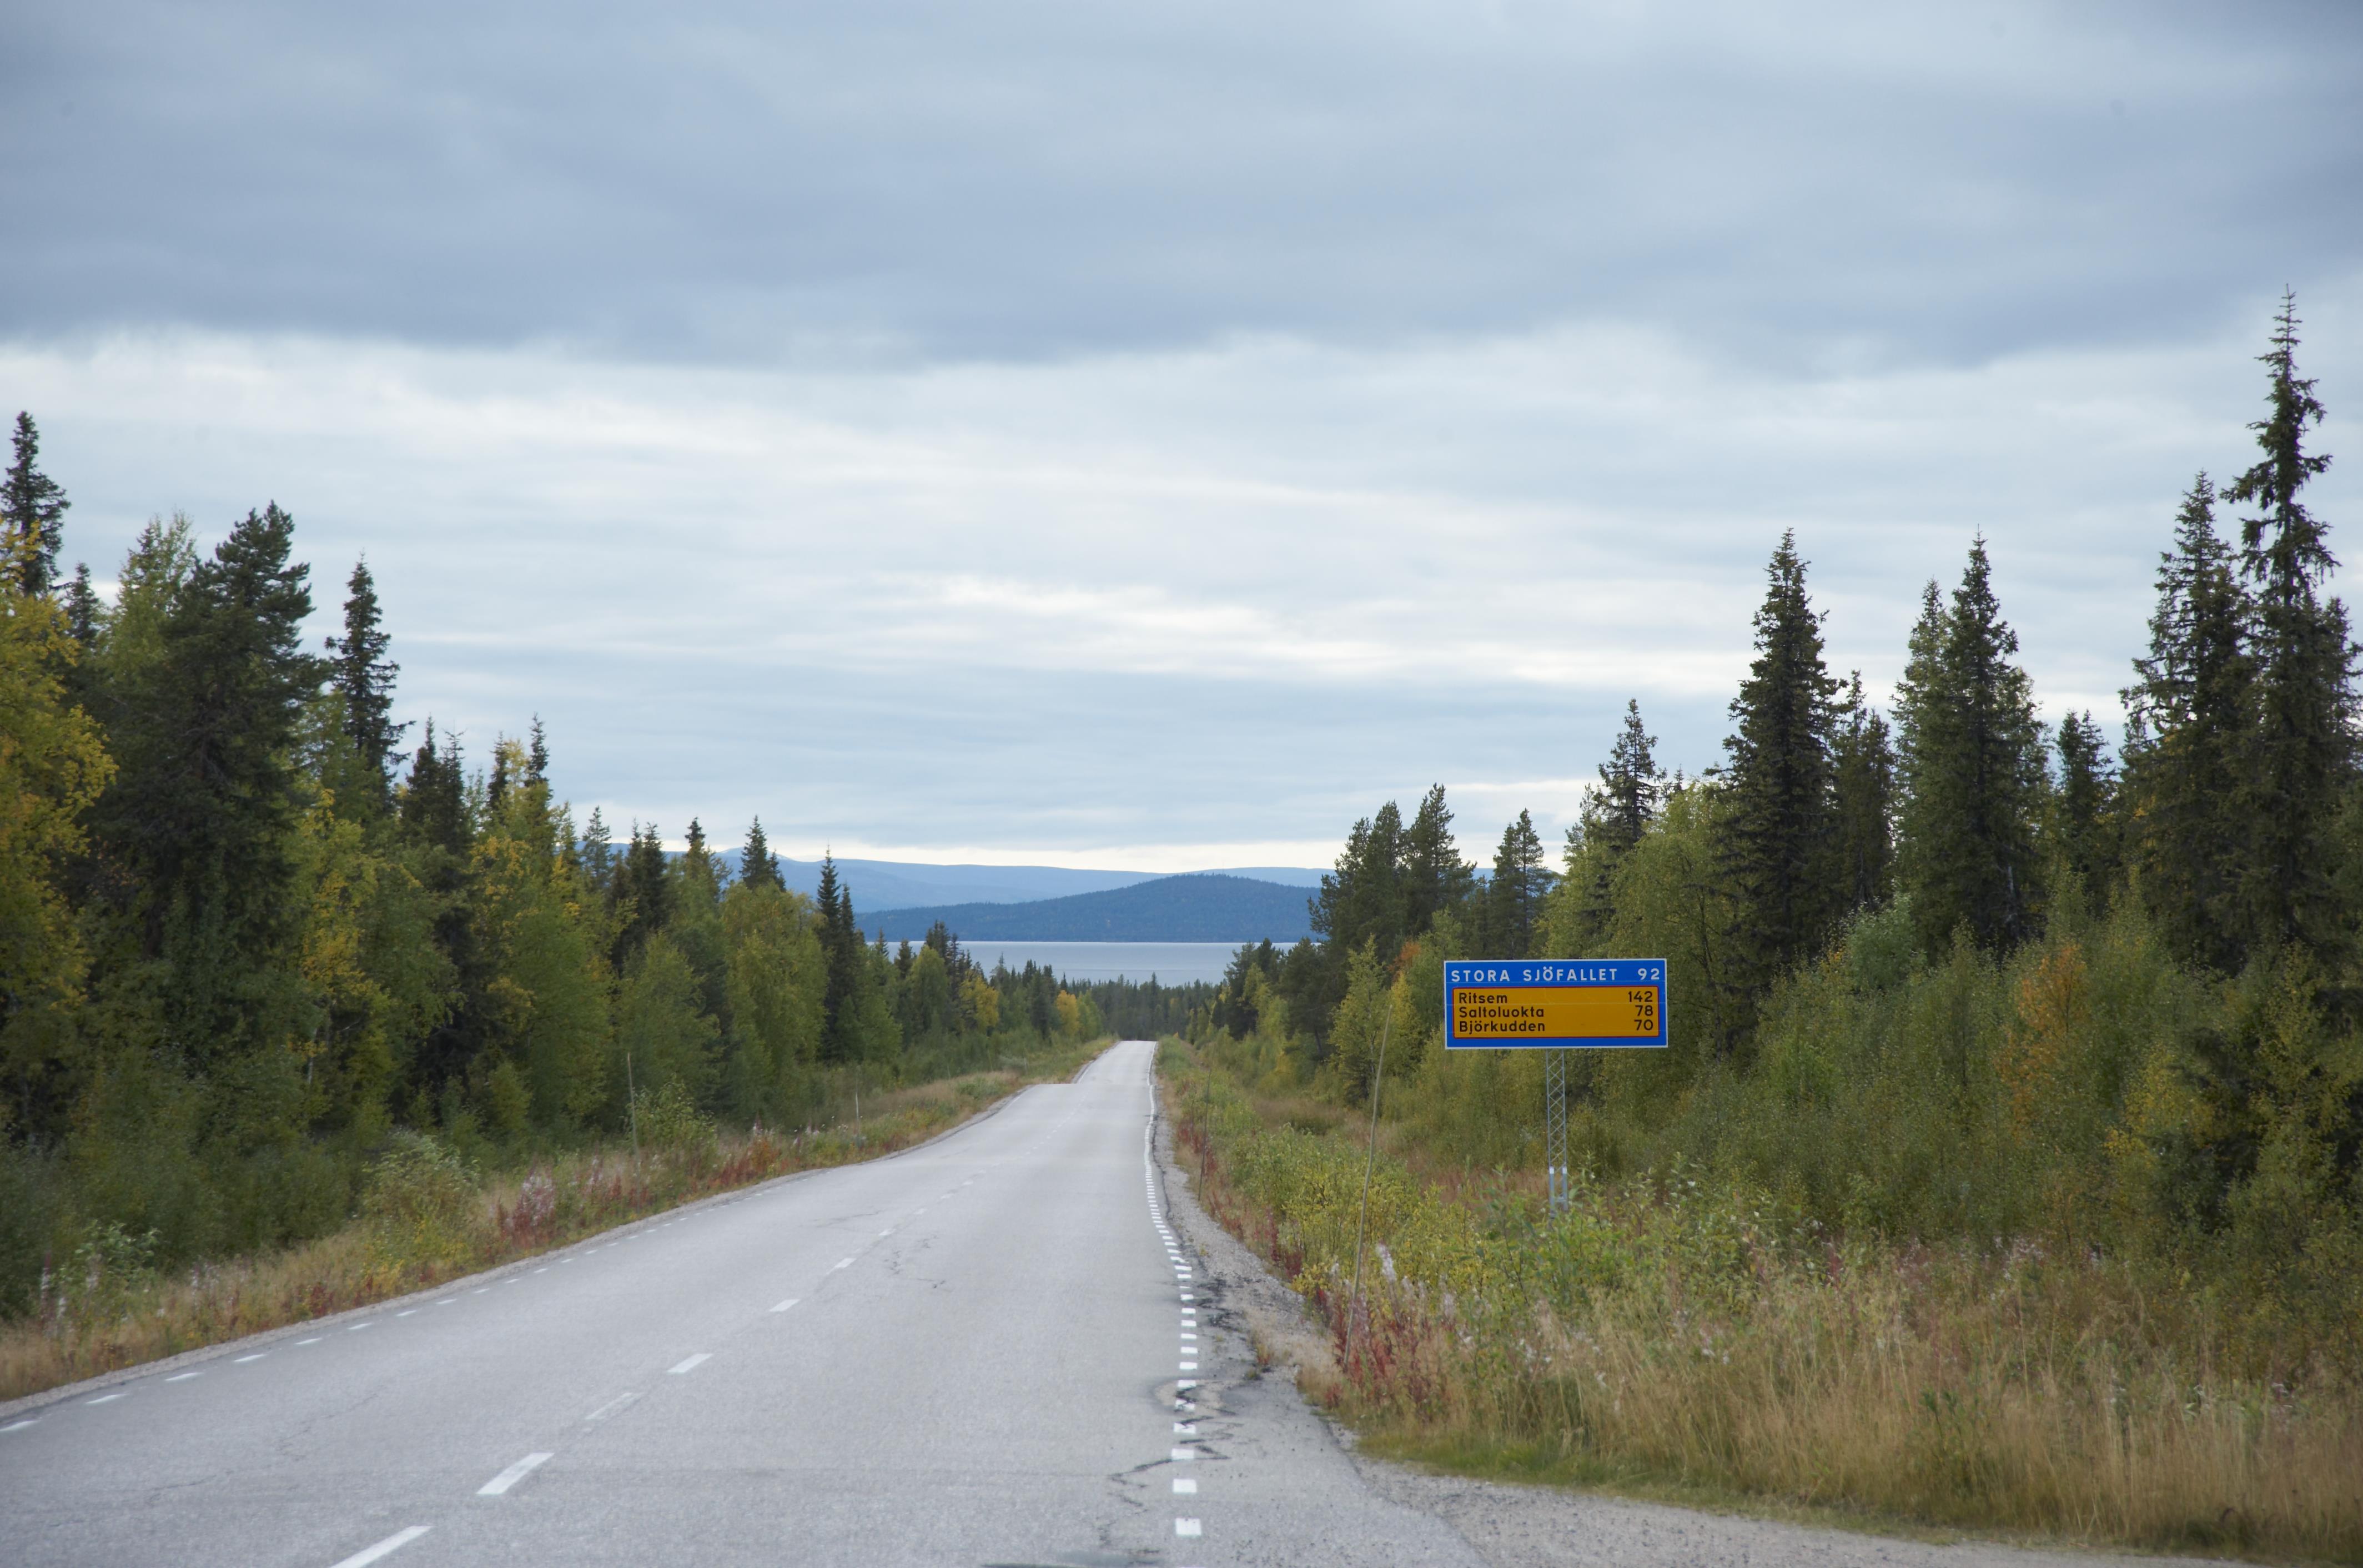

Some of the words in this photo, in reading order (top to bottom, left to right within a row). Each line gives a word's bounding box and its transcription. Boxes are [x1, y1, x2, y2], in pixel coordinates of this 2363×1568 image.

[1451, 969, 1510, 982] STORA
[1524, 967, 1617, 981] SJÖFALLET
[1638, 968, 1660, 979] 92
[1459, 993, 1507, 1003] Ritsem
[1628, 991, 1653, 1002] 142
[1459, 1007, 1544, 1018] Saltoluokta
[1635, 1006, 1653, 1016] 78
[1460, 1021, 1545, 1034] Björkudden
[1635, 1019, 1653, 1031] 70
